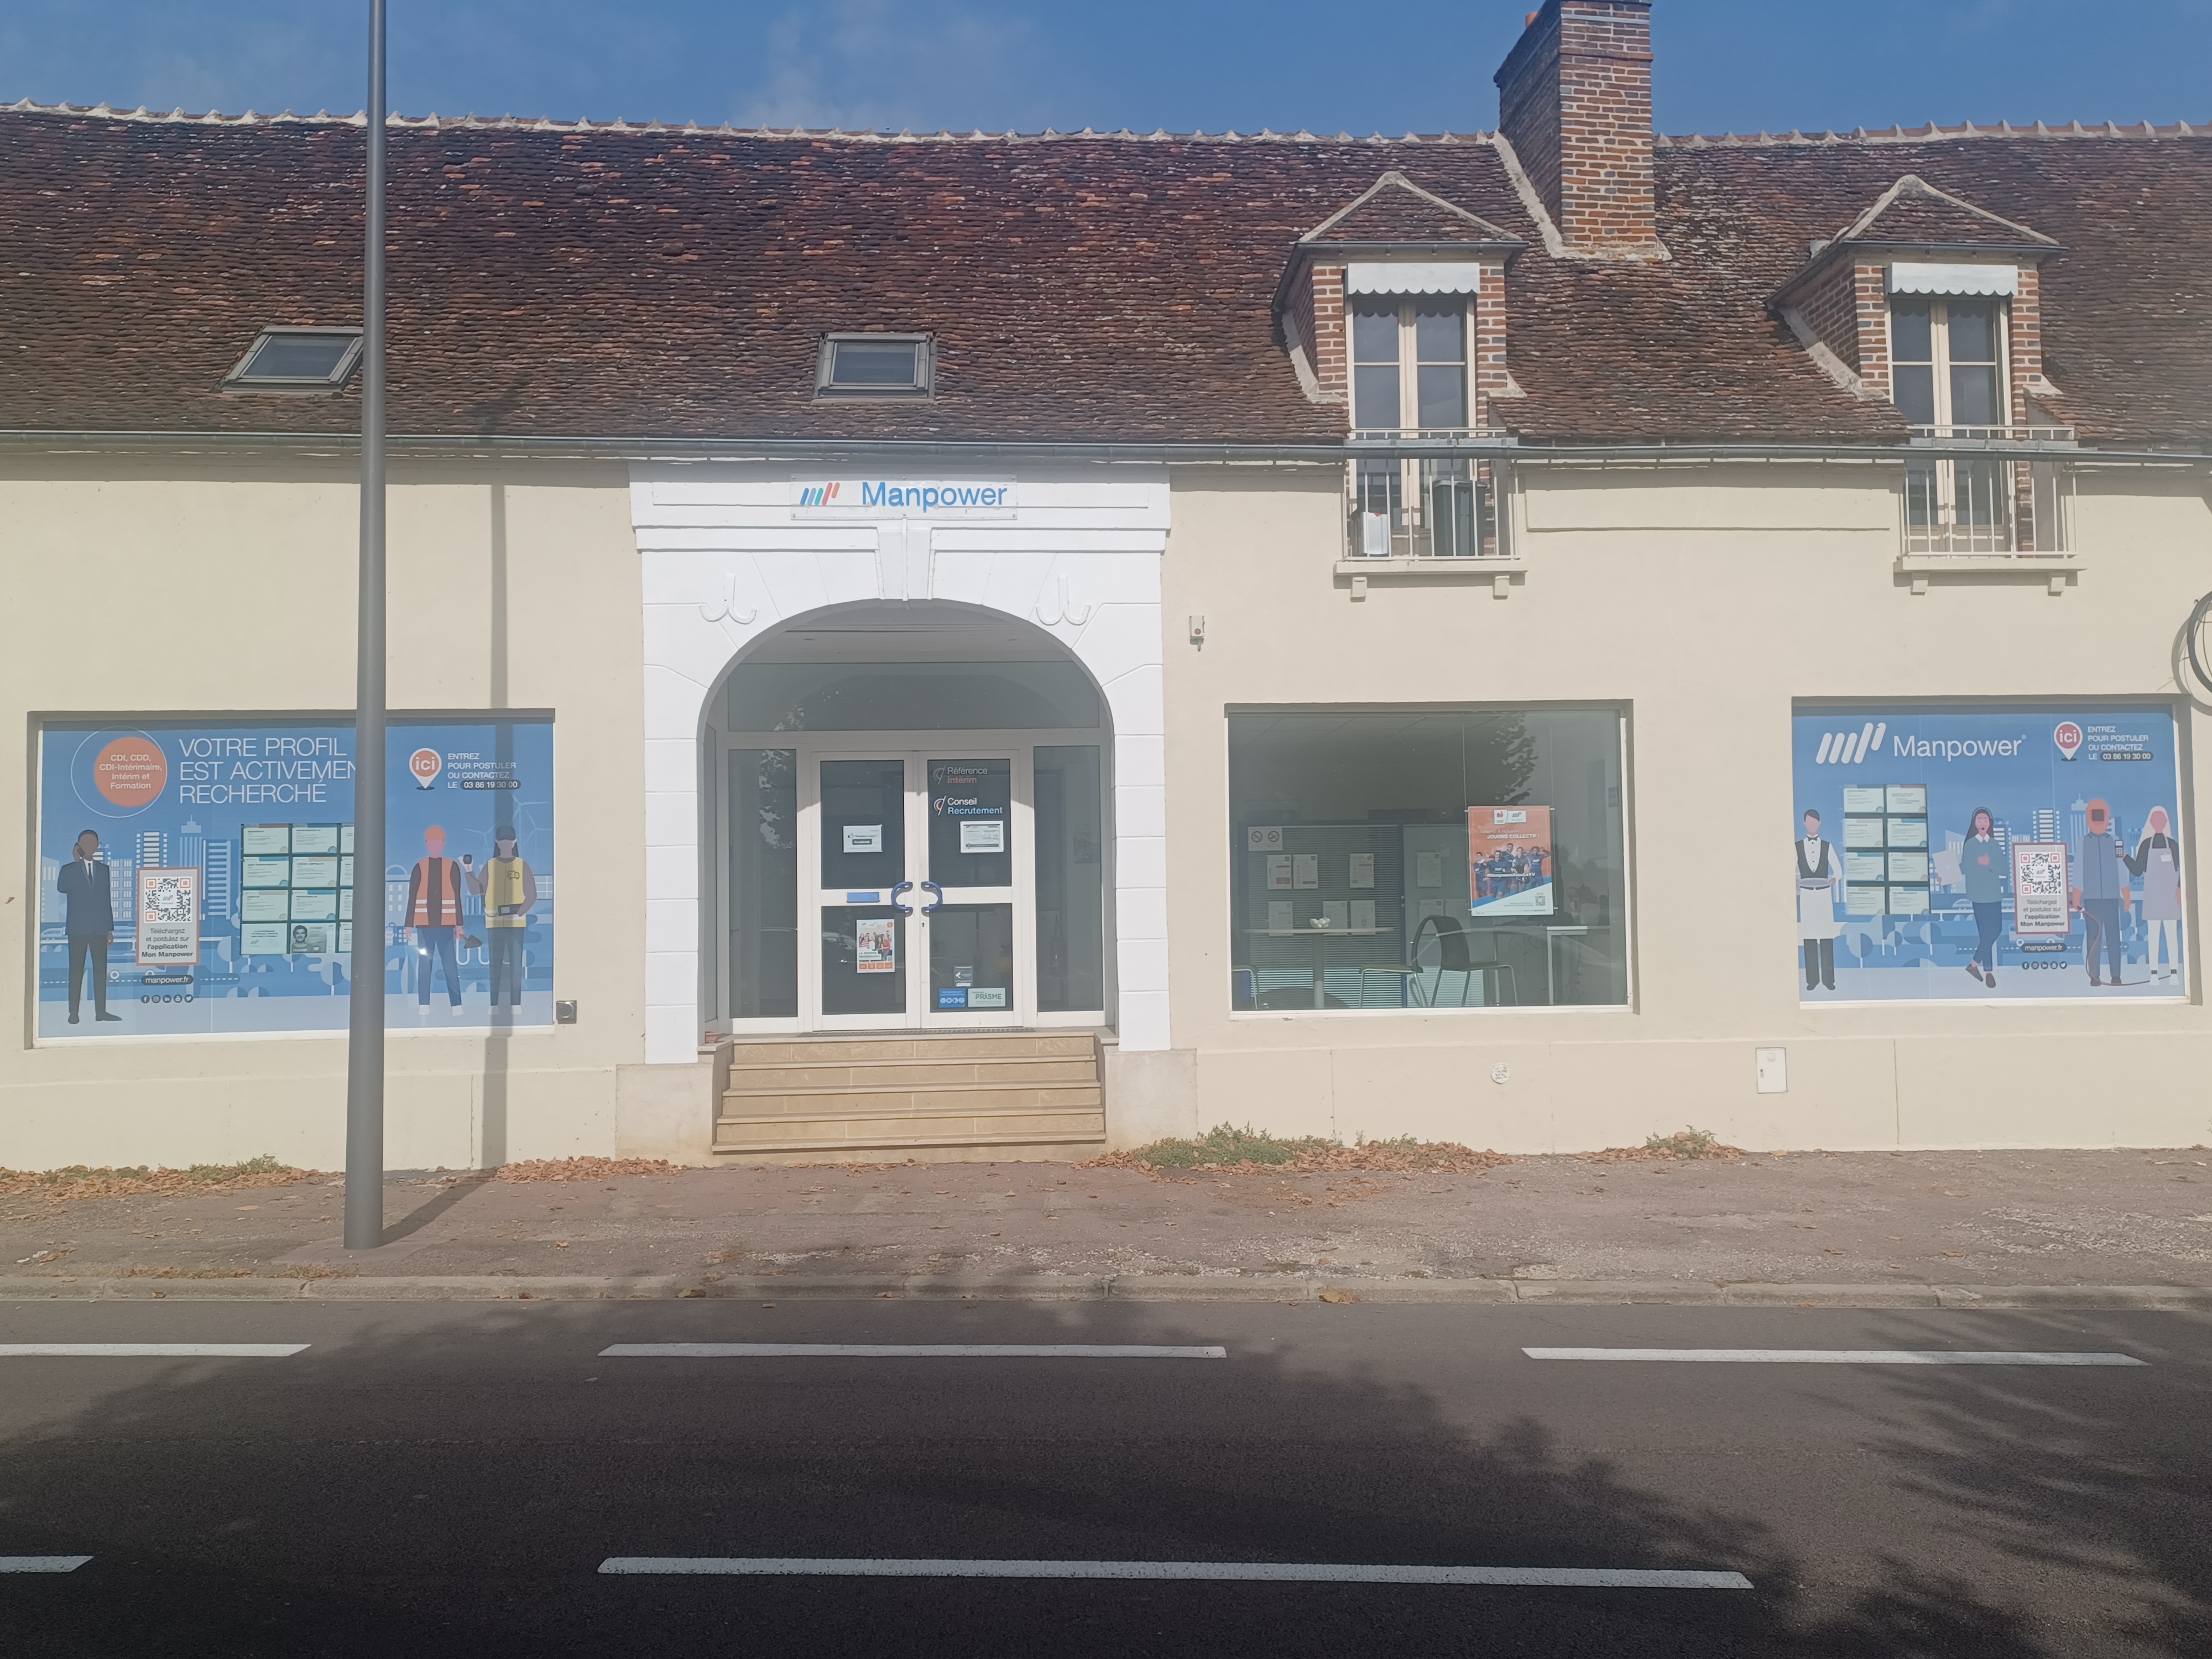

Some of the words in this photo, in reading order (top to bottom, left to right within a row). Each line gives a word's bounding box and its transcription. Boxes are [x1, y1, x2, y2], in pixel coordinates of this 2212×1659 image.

[862, 482, 1008, 513] Manpower
[2059, 729, 2077, 743] ici
[179, 738, 257, 757] VOTRE
[265, 737, 347, 757] PROFIL
[1893, 735, 2022, 762] Manpower
[180, 761, 224, 780] EST
[230, 760, 356, 780] ACTIVEMEN
[416, 757, 435, 770] ici
[180, 779, 327, 804] RECHERCHÉ
[145, 976, 189, 984] manpower.fr
